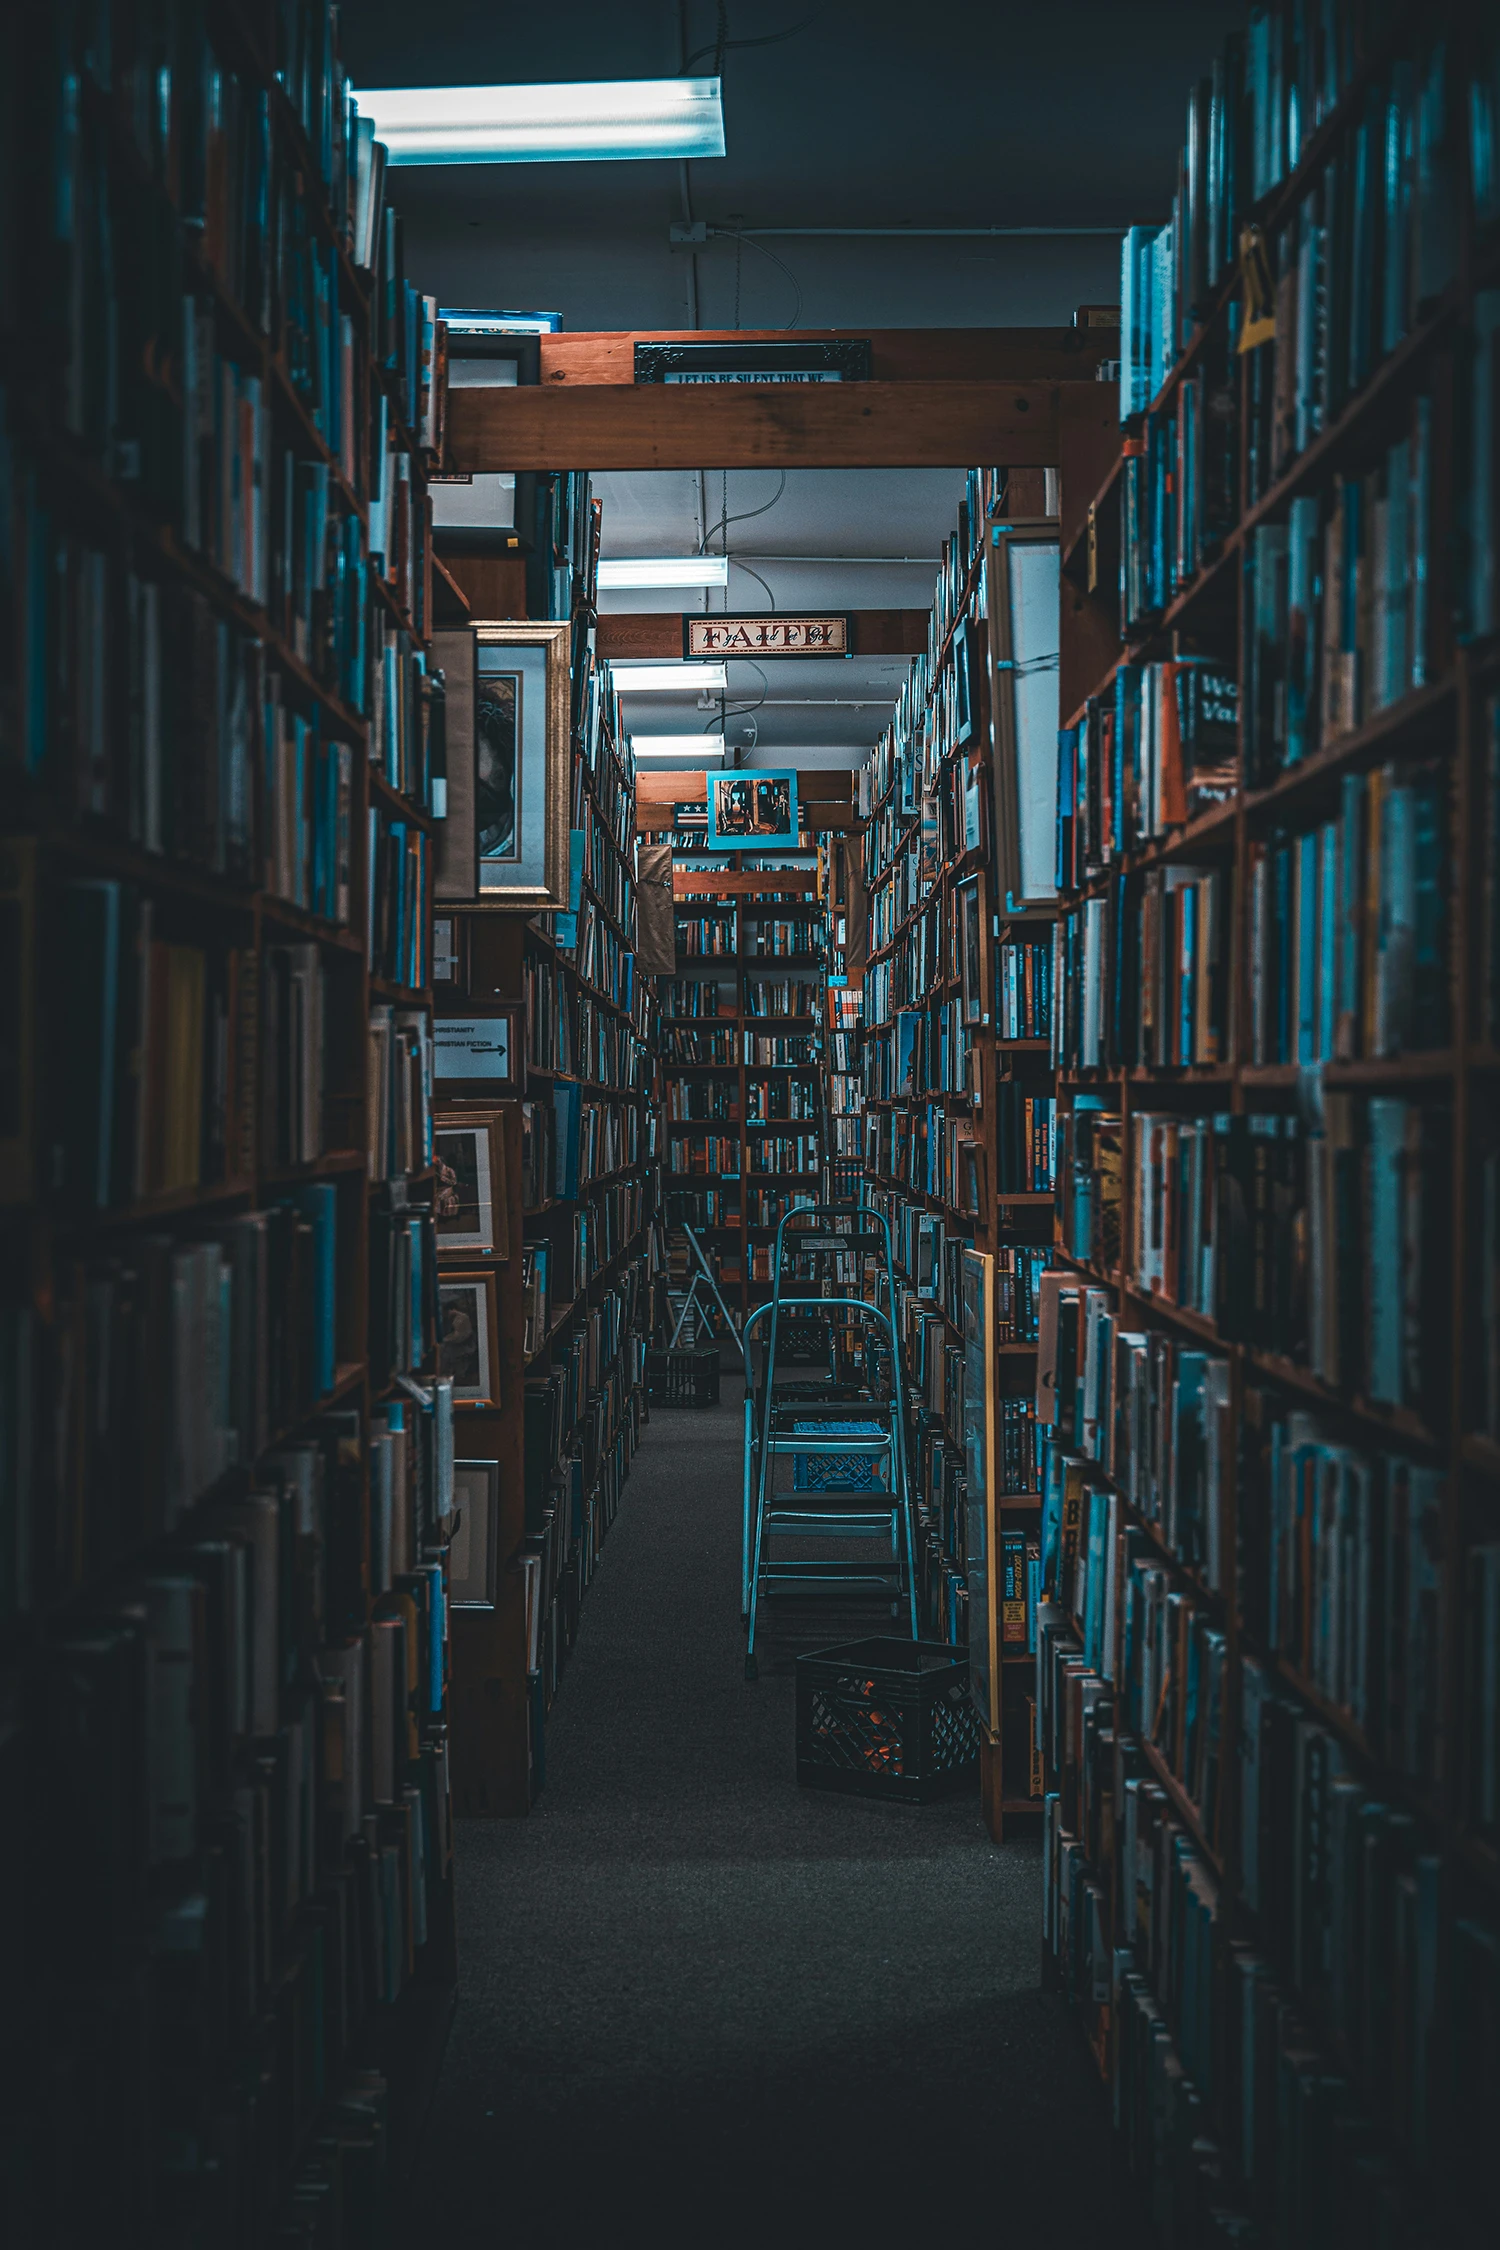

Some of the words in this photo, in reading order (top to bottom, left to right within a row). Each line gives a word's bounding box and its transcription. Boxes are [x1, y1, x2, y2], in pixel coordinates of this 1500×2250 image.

[678, 374, 699, 384] LET
[701, 374, 715, 384] US
[719, 374, 733, 383] BE
[736, 374, 774, 383] SILENT
[777, 373, 805, 383] THAT
[808, 373, 824, 382] WE
[702, 623, 833, 648] FAITH
[703, 630, 716, 642] let
[723, 635, 747, 647] go
[756, 631, 778, 641] and
[787, 630, 798, 641] let
[805, 626, 833, 644] God
[1006, 1566, 1014, 1598] MYSTERIES
[1014, 1554, 1023, 1600] LOCKED-ROOM
